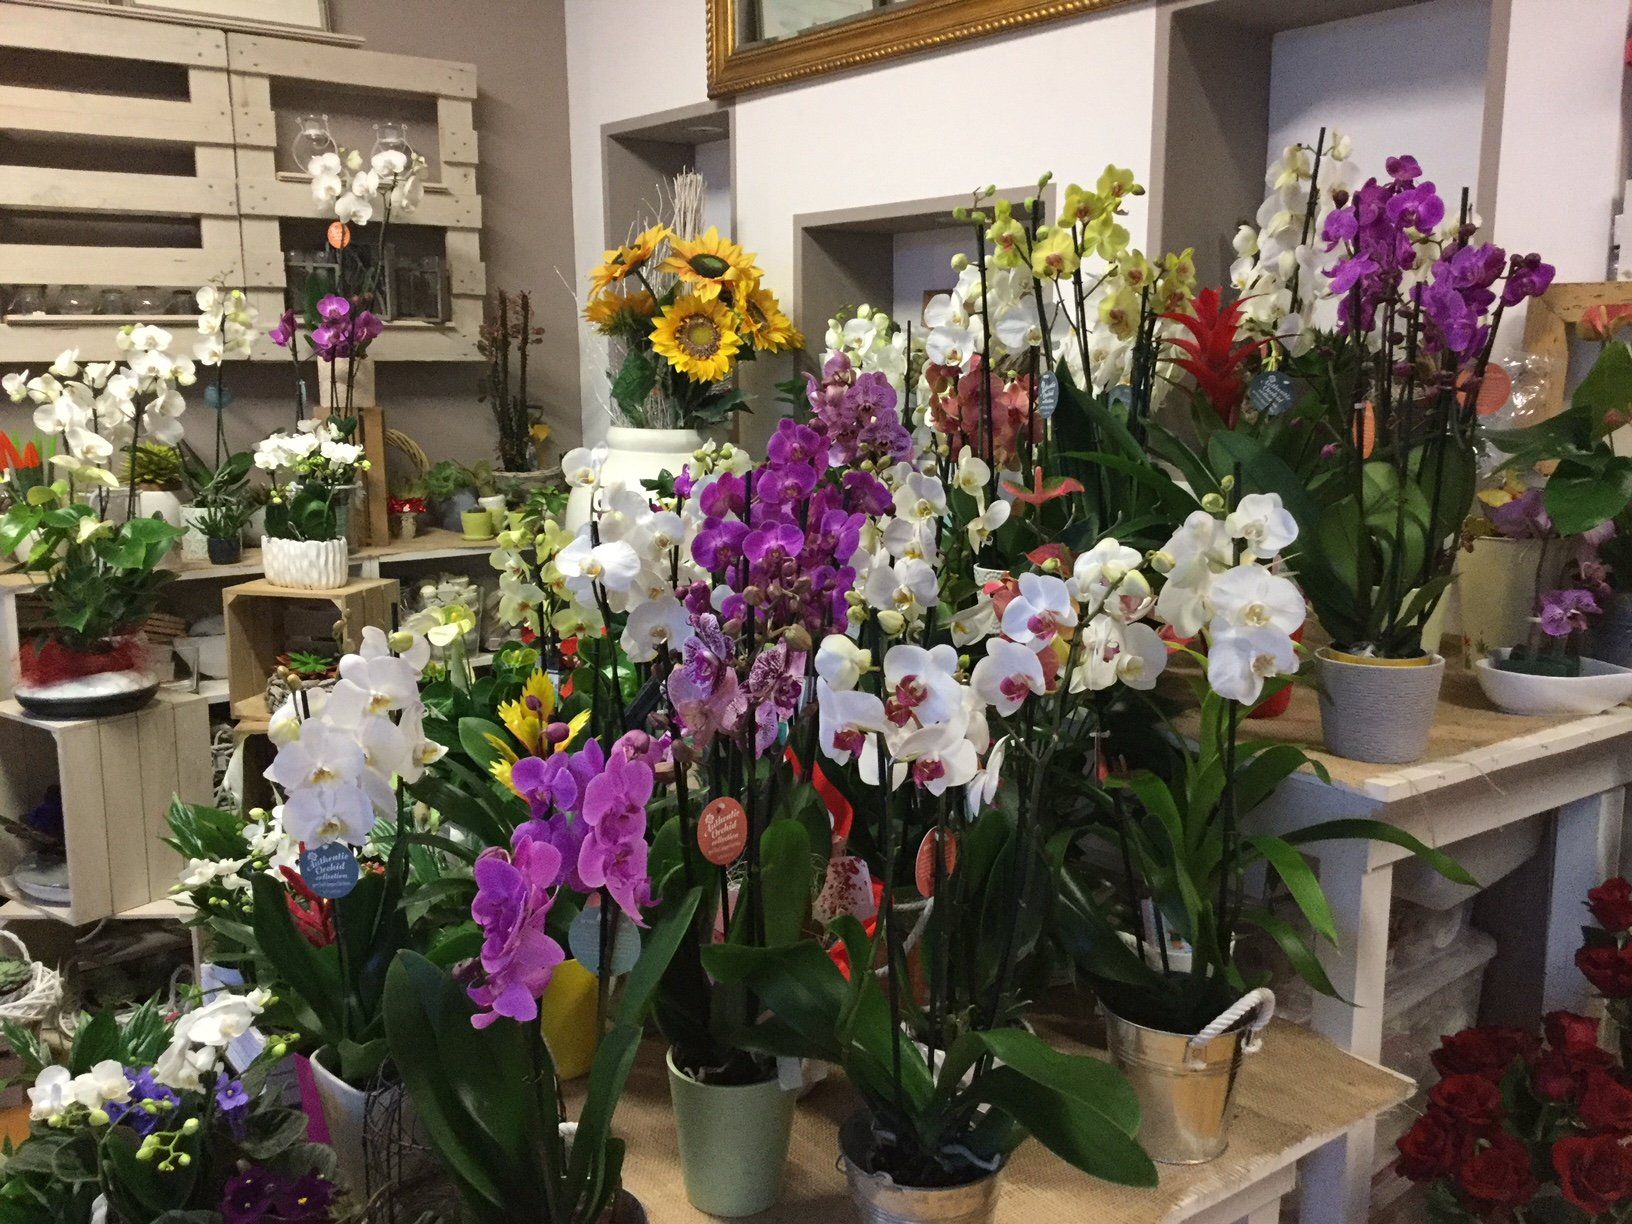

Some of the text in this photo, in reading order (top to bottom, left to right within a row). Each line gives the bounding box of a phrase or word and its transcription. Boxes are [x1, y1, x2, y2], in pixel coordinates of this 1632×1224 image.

[704, 809, 740, 837] Authentic
[711, 820, 737, 839] Orchid
[307, 852, 349, 871] Authentic
[315, 861, 346, 875] Orchid
